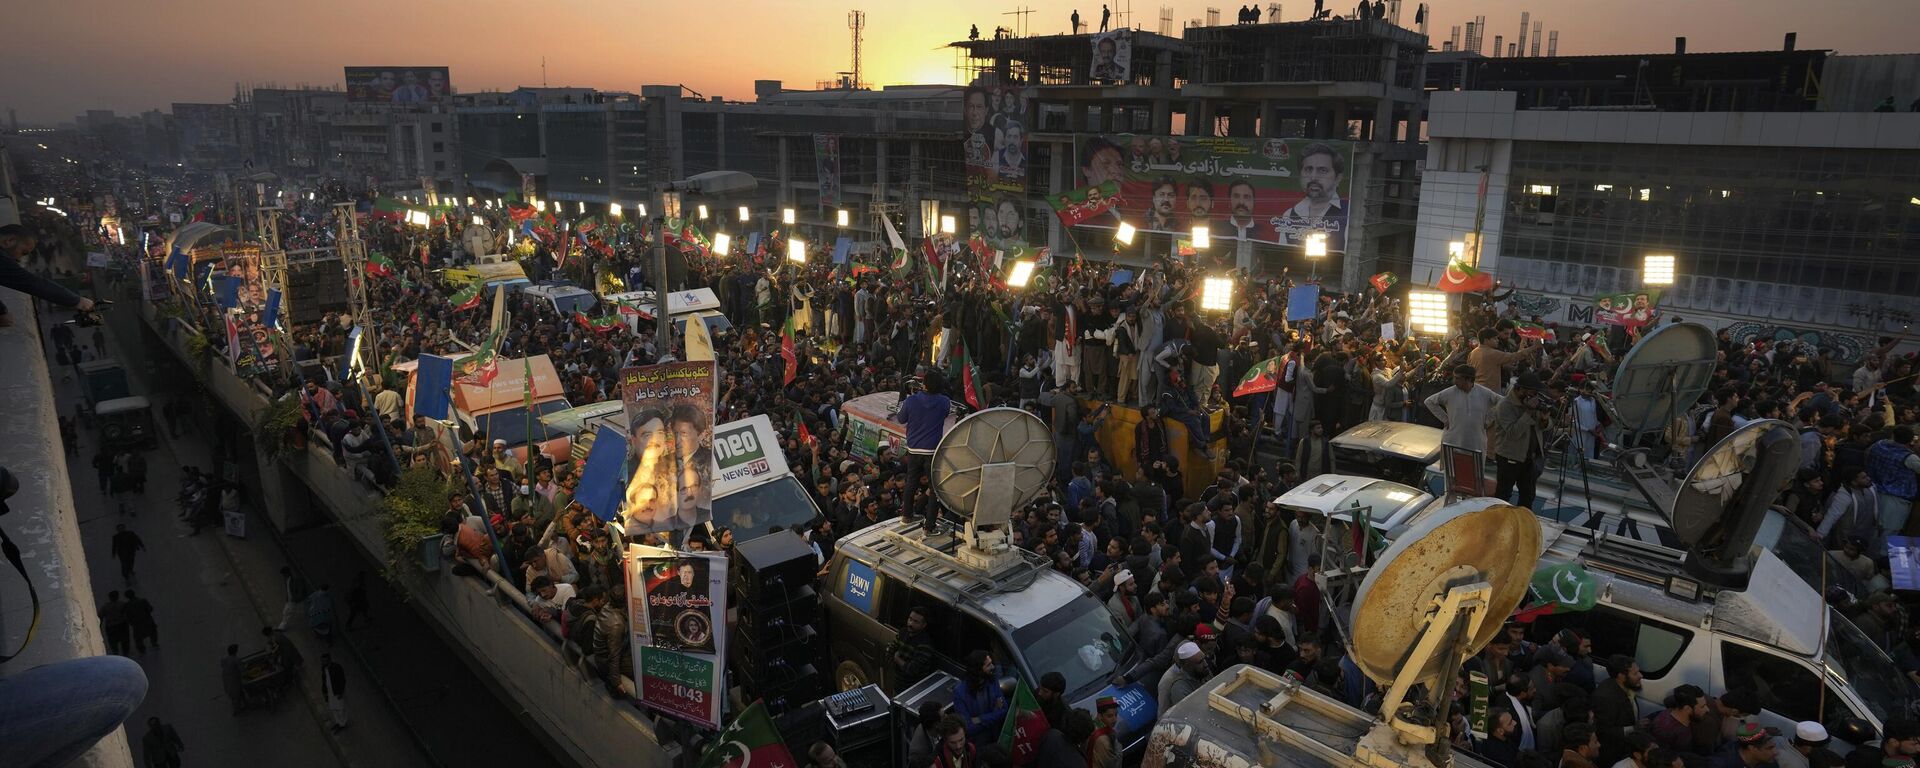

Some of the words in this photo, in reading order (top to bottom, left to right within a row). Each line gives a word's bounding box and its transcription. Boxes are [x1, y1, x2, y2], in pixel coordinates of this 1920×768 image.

[1131, 158, 1183, 173] مارچ
[1184, 155, 1224, 176] آزادی
[1220, 160, 1291, 178] حقیقی
[626, 371, 647, 386] خاطر
[647, 369, 659, 383] کی
[661, 367, 691, 381] پاکستان
[635, 387, 656, 402] خاطر
[657, 385, 669, 398] کی
[689, 384, 701, 397] حق
[714, 430, 758, 461] neo
[722, 467, 750, 482] NEWS
[749, 460, 769, 475] HD
[850, 573, 870, 592] DAWN
[1116, 688, 1143, 711] DAWN
